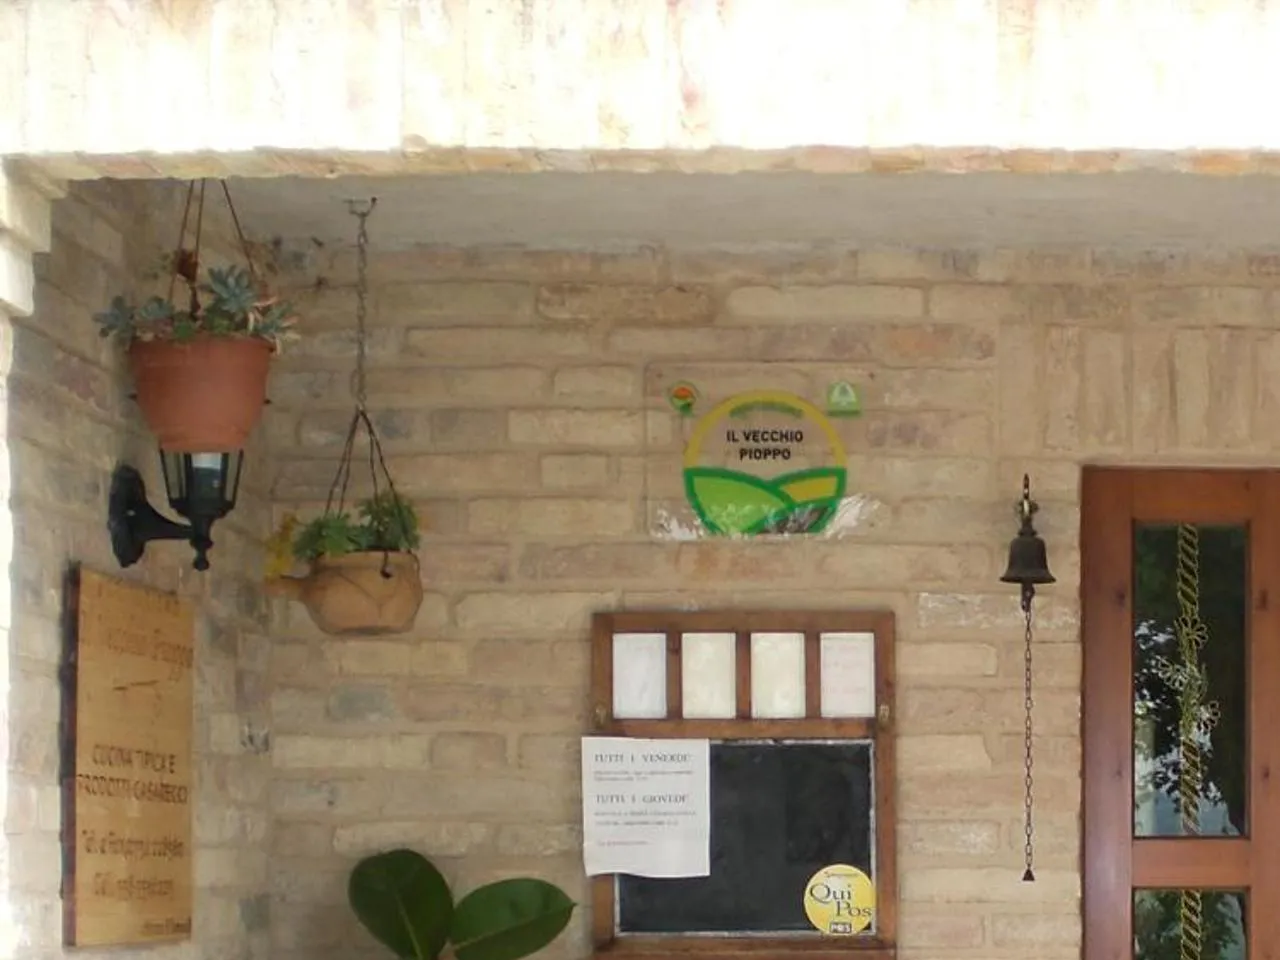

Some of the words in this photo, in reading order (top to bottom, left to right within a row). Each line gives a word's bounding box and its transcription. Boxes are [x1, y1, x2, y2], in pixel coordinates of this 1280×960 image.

[726, 429, 740, 442] IL
[743, 429, 803, 443] VECCHIO
[739, 447, 791, 461] PIOPPO
[595, 753, 624, 763] TUTTI
[596, 794, 625, 804] TUTTI
[810, 883, 852, 904] Qui
[836, 901, 872, 917] Pos
